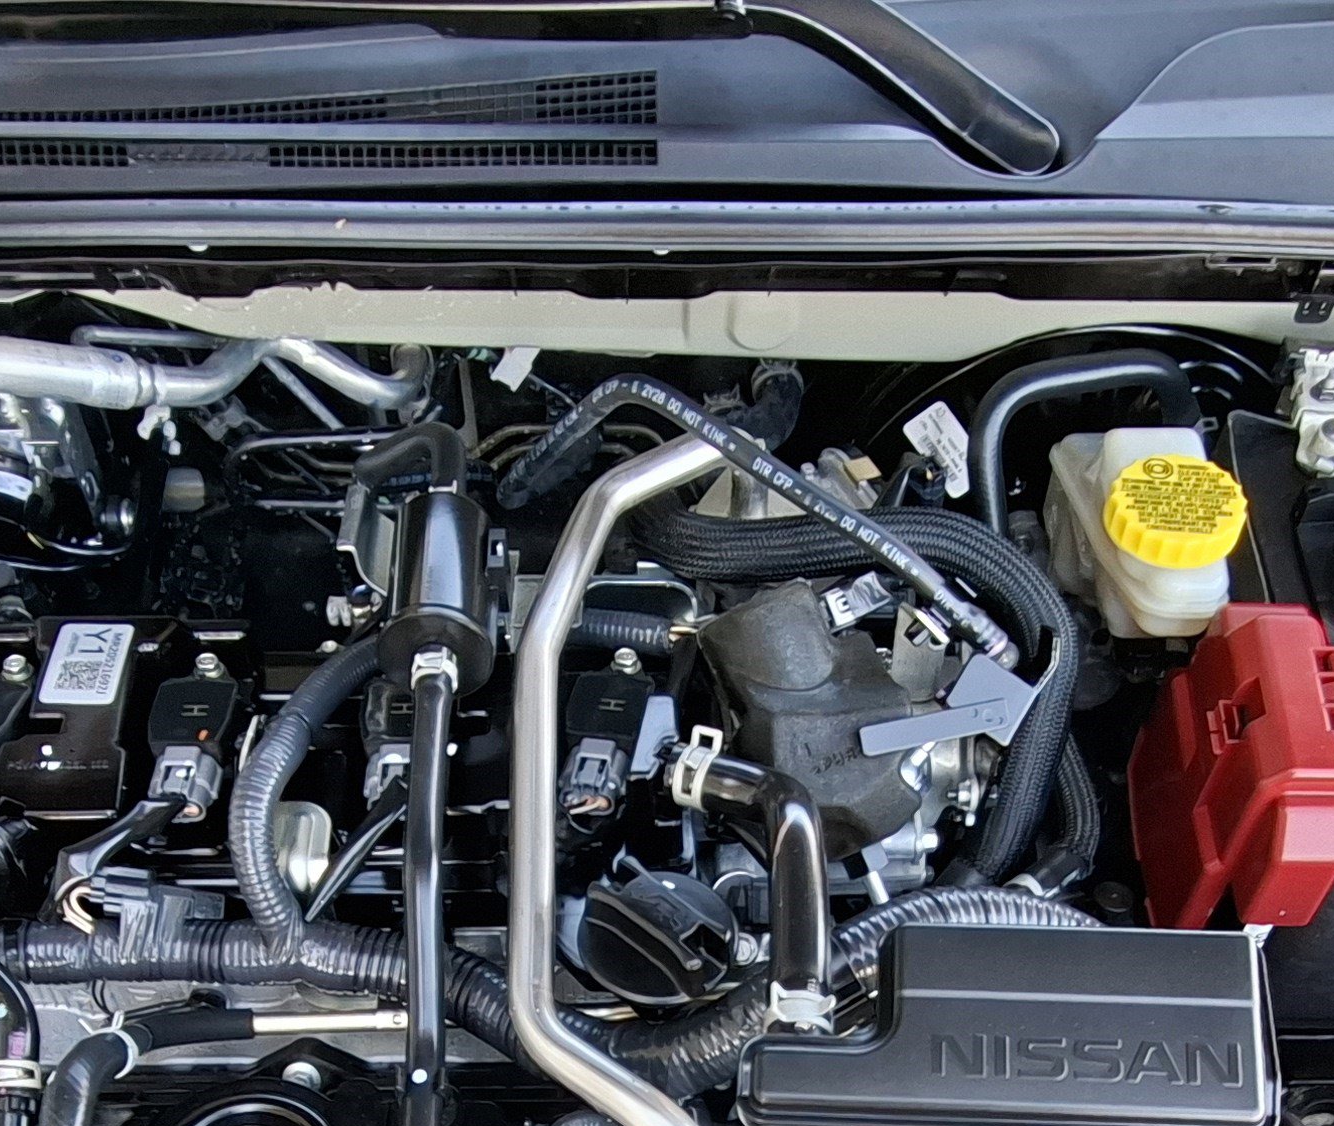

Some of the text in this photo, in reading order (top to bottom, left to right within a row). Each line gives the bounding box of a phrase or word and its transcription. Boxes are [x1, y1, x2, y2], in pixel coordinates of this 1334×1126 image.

[667, 397, 681, 415] DO
[682, 407, 703, 429] NOT
[701, 421, 728, 448] KINK
[839, 514, 857, 532] DO
[857, 524, 881, 546] NOT
[880, 541, 910, 570] KINK
[77, 627, 113, 654] Y1
[930, 1033, 1244, 1089] NISSAN
